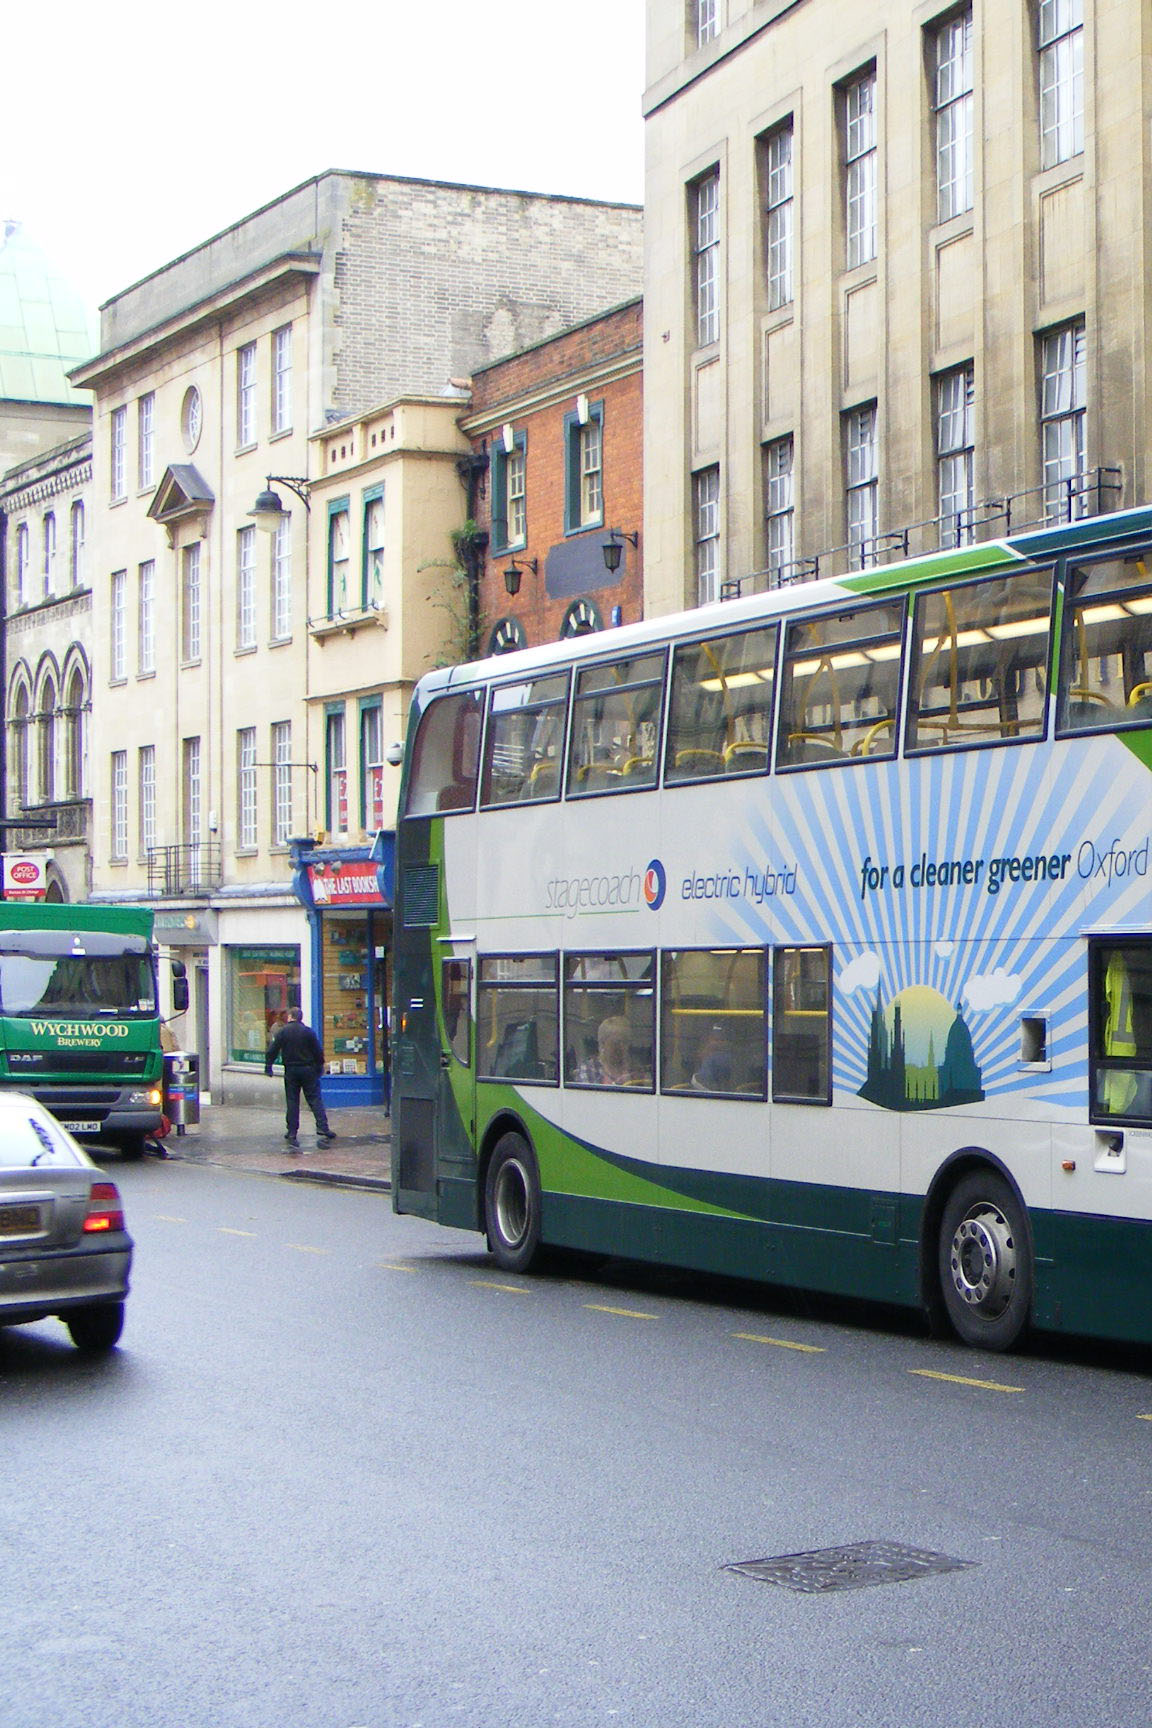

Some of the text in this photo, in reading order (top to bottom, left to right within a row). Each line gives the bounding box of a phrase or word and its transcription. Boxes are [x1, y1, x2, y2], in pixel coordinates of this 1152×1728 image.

[861, 836, 1150, 901] for a cleaner greener Oxford
[322, 878, 338, 895] THE
[337, 876, 353, 894] LAST
[681, 863, 798, 904] electric hybrid
[545, 865, 642, 920] stagecoach
[31, 1021, 129, 1037] WYCHWOOD
[57, 1037, 103, 1047] BREWERY
[9, 1054, 44, 1063] DAF
[61, 1122, 80, 1131] M02
